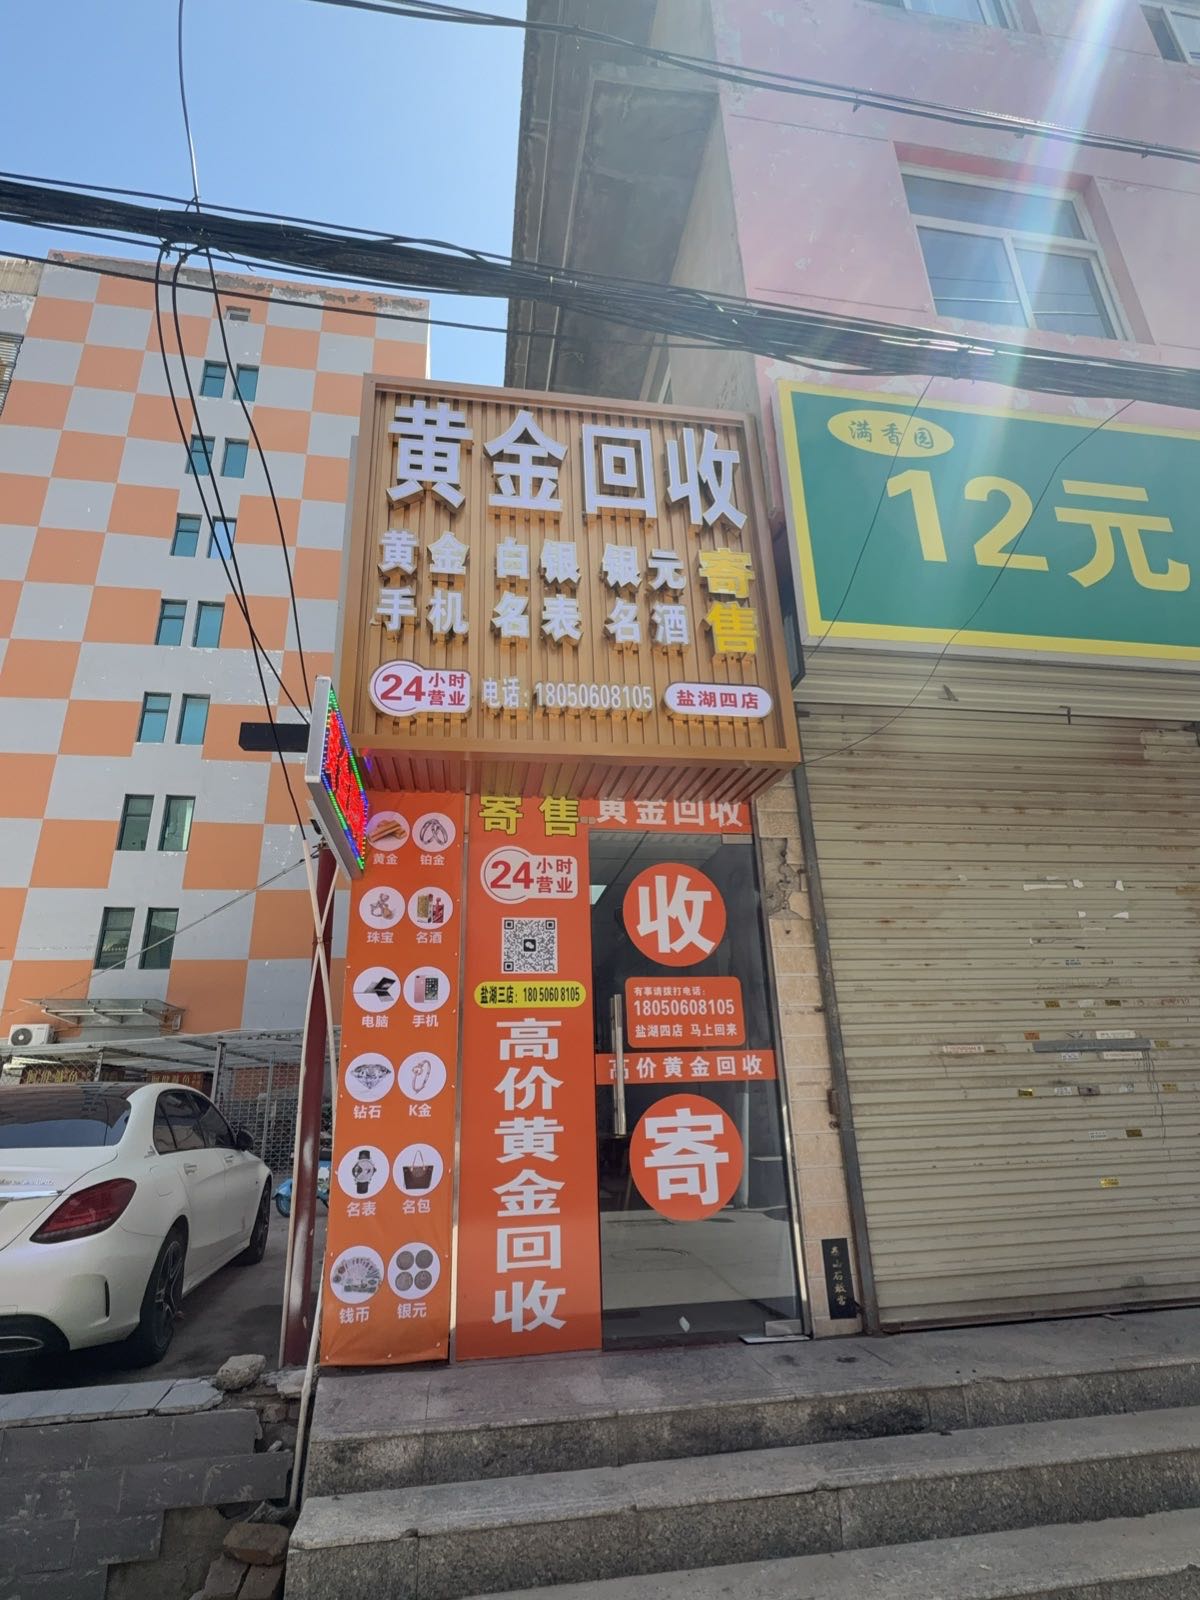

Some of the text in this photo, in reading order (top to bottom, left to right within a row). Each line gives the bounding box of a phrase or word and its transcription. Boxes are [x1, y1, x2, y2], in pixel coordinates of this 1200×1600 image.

[386, 400, 747, 530] 黄金回收
[886, 469, 1190, 592] 12元
[379, 529, 687, 590] 黄金 白银 银元
[698, 547, 757, 655] 寄售
[376, 587, 690, 646] 手机 名表 名酒
[380, 673, 426, 701] 24
[428, 671, 467, 687] 小时
[427, 688, 466, 706] 营业
[676, 689, 759, 710] 盐湖四店
[479, 797, 579, 837] 寄售
[597, 799, 743, 827] 黄金回收
[373, 853, 399, 866] 黄金
[420, 854, 445, 866] 铂金
[536, 857, 573, 875] 小时
[490, 860, 534, 890] 24
[536, 876, 573, 894] 营业
[636, 874, 716, 955] 收
[366, 931, 394, 945] 珠宝
[416, 931, 443, 945] 名酒
[633, 999, 735, 1016] 18050608105
[361, 1015, 389, 1028] 电脑
[412, 1014, 439, 1027] 手机
[635, 1023, 738, 1038] 盐湖四店 马上回来
[608, 1054, 763, 1080] 高价黄金回收
[353, 1104, 382, 1119] 钻石
[408, 1103, 432, 1118] K金
[644, 1108, 730, 1205] 寄
[491, 1018, 567, 1333] 高价黄金回收
[346, 1201, 377, 1217] 名表
[402, 1198, 431, 1214] 名包
[338, 1306, 370, 1325] 钱币
[397, 1302, 427, 1319] 银元
